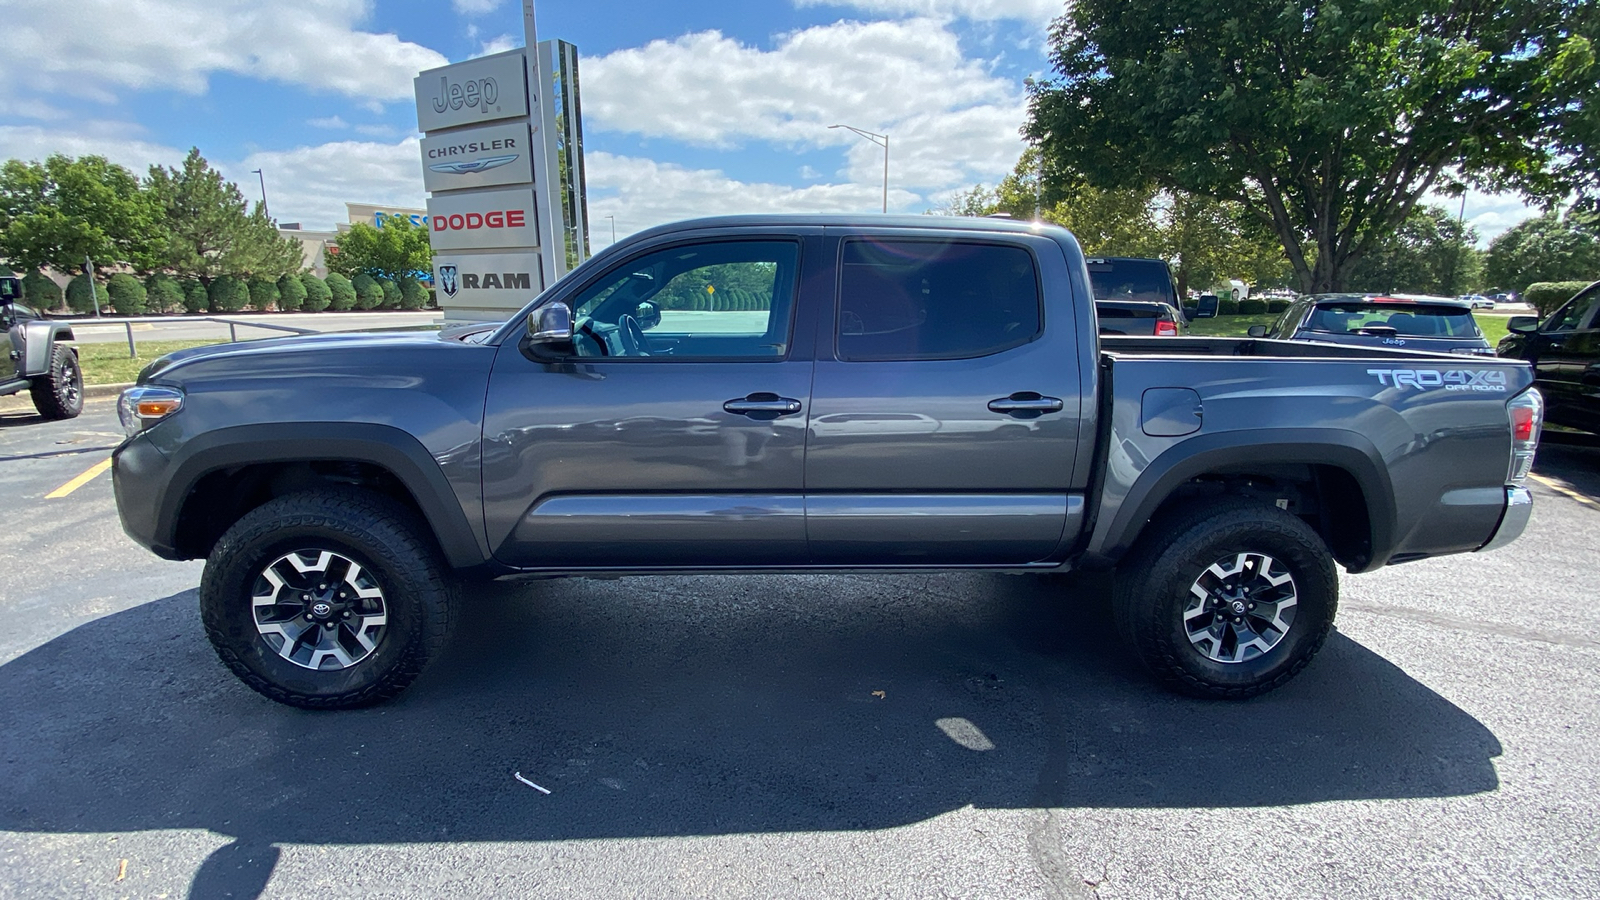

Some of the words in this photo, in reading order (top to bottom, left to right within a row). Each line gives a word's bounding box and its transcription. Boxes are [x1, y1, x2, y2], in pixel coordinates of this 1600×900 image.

[432, 76, 499, 114] Jeep
[428, 138, 517, 159] CHRYSLER
[433, 210, 525, 232] DODGE
[462, 273, 531, 289] RAM
[1382, 338, 1406, 347] Jeep
